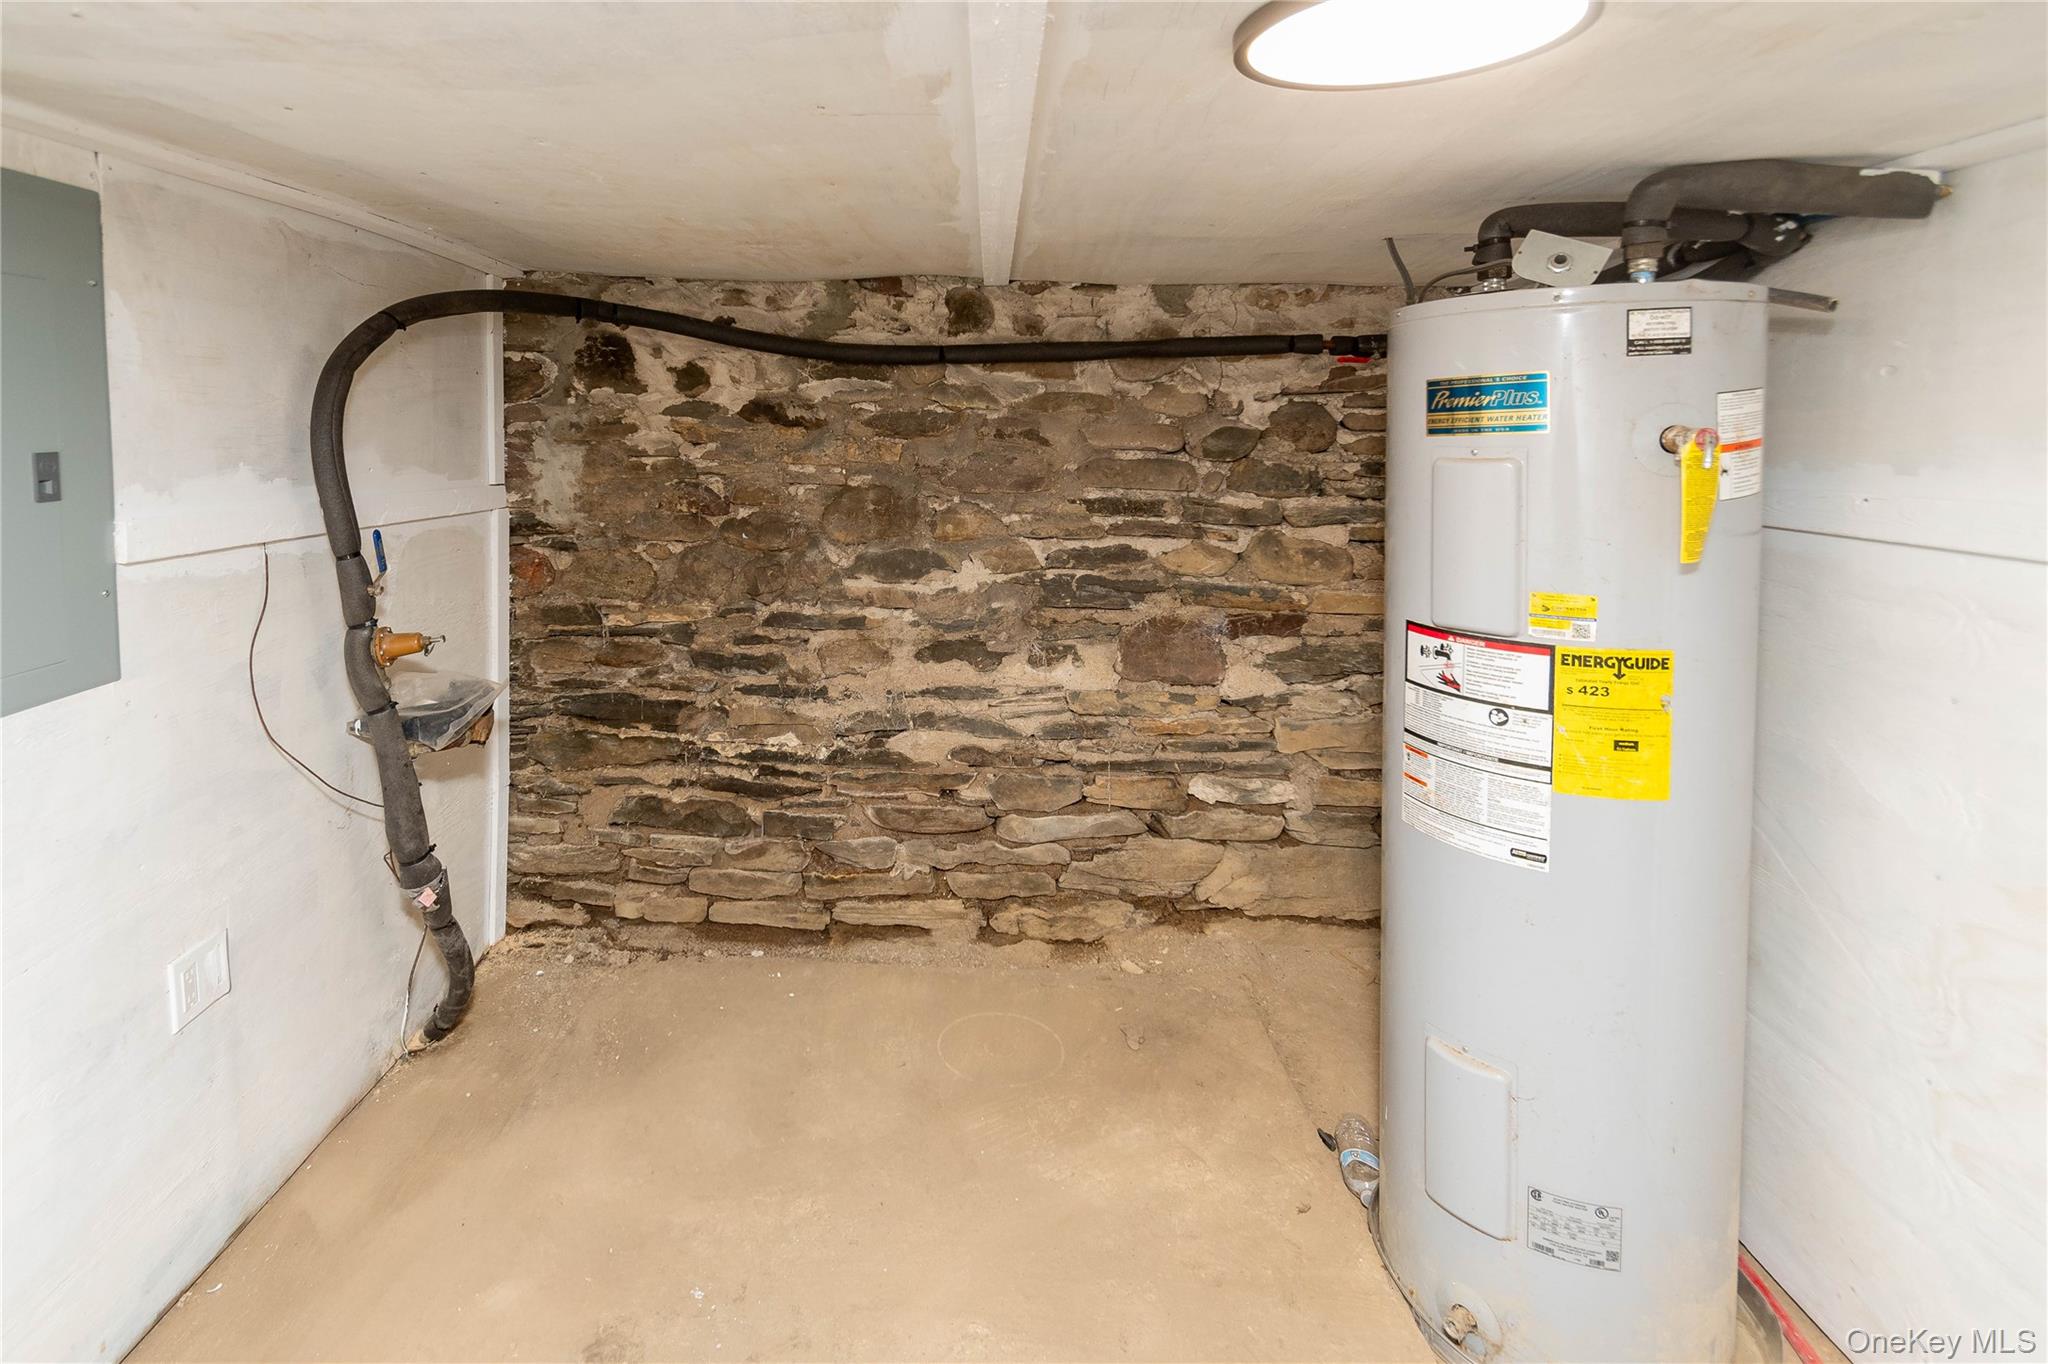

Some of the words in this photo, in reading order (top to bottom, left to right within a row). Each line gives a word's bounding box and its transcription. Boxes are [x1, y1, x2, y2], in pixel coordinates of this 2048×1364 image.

[1450, 416, 1485, 424] EFFICIENT
[1516, 414, 1548, 422] HEATER
[1455, 636, 1486, 648] DANGER
[1560, 653, 1670, 672] ENERGYGUIDE
[1578, 685, 1610, 697] 423
